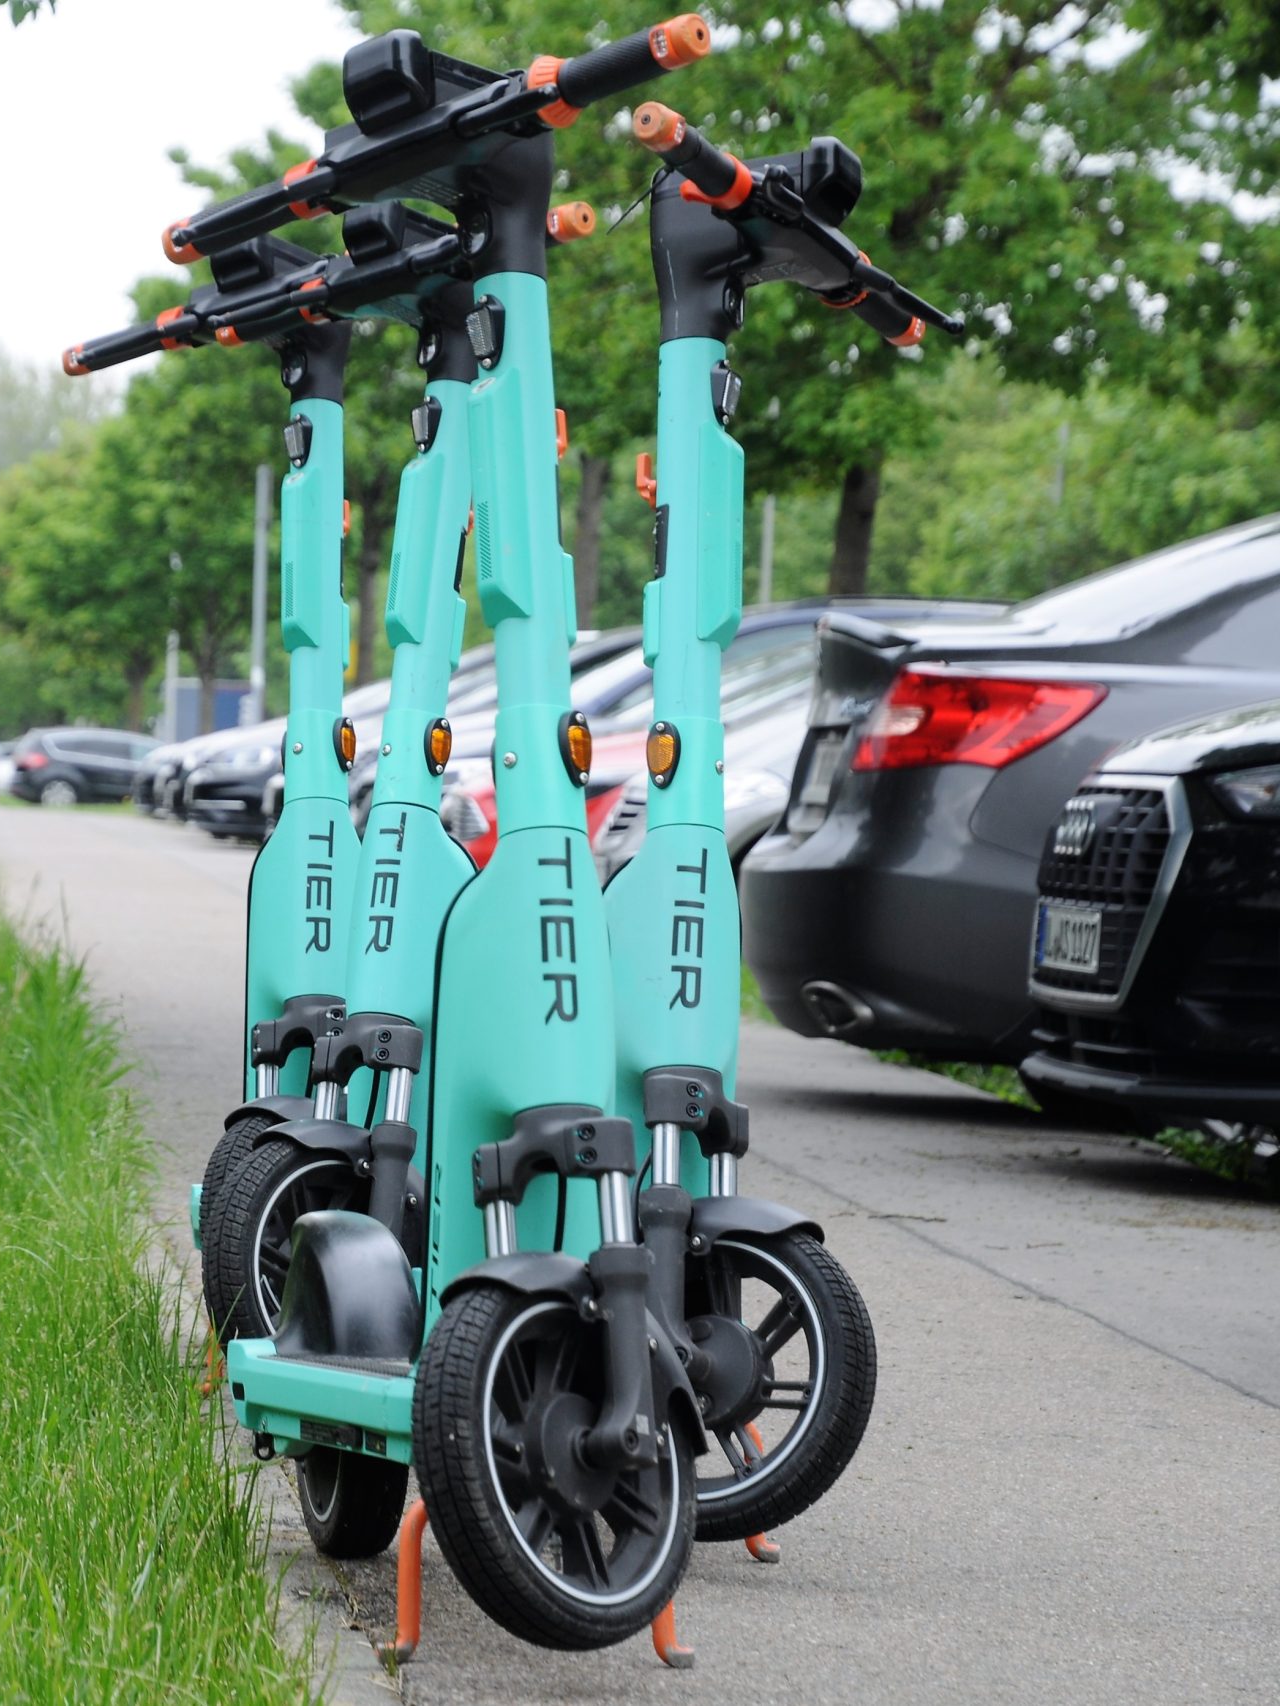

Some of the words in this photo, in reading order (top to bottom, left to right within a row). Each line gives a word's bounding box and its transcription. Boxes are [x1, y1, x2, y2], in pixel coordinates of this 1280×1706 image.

[305, 820, 334, 954] TIER
[365, 812, 407, 955] TIER
[538, 836, 578, 1025] TIER
[669, 848, 708, 1010] TIER
